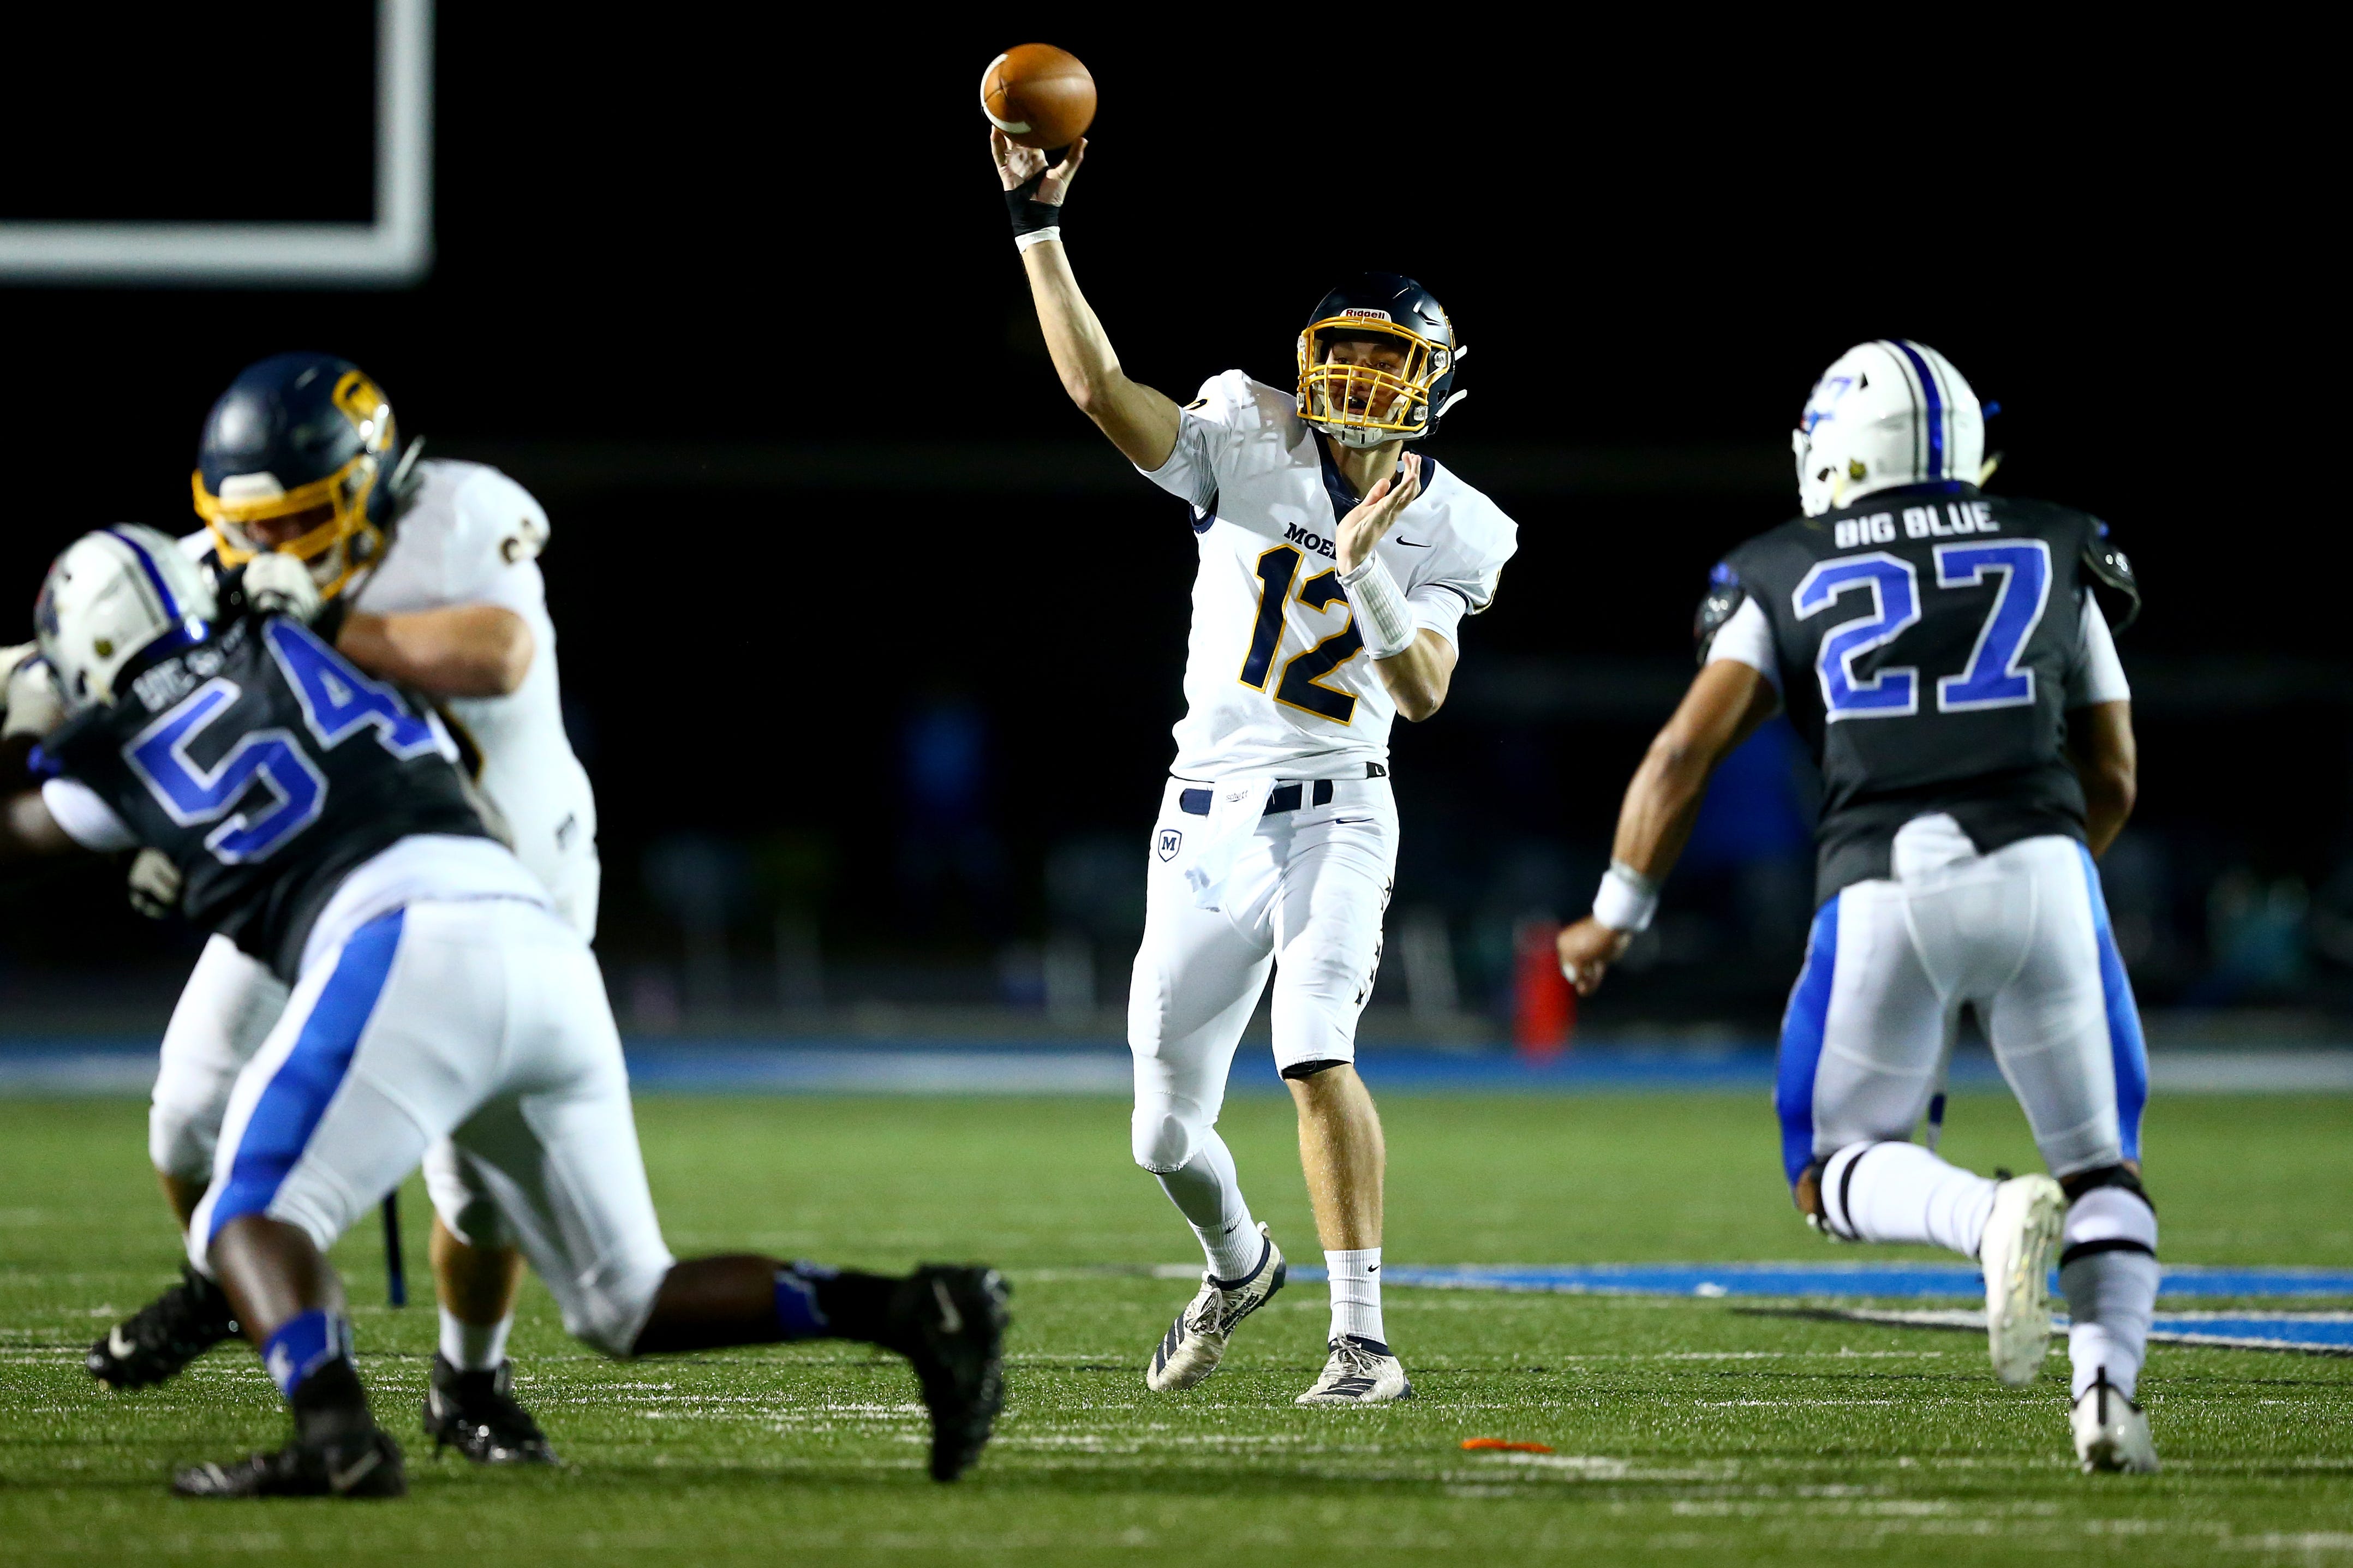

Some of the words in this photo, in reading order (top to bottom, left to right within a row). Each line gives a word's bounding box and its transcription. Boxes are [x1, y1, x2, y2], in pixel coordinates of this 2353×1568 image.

[1346, 309, 1385, 319] Riddell
[1283, 522, 1337, 560] MOE
[1834, 512, 1896, 549] BIG
[1902, 501, 2000, 539] BLUE
[1238, 544, 1364, 726] 12
[1792, 538, 2053, 724] 27
[122, 615, 459, 865] 54
[1162, 836, 1176, 851] M
